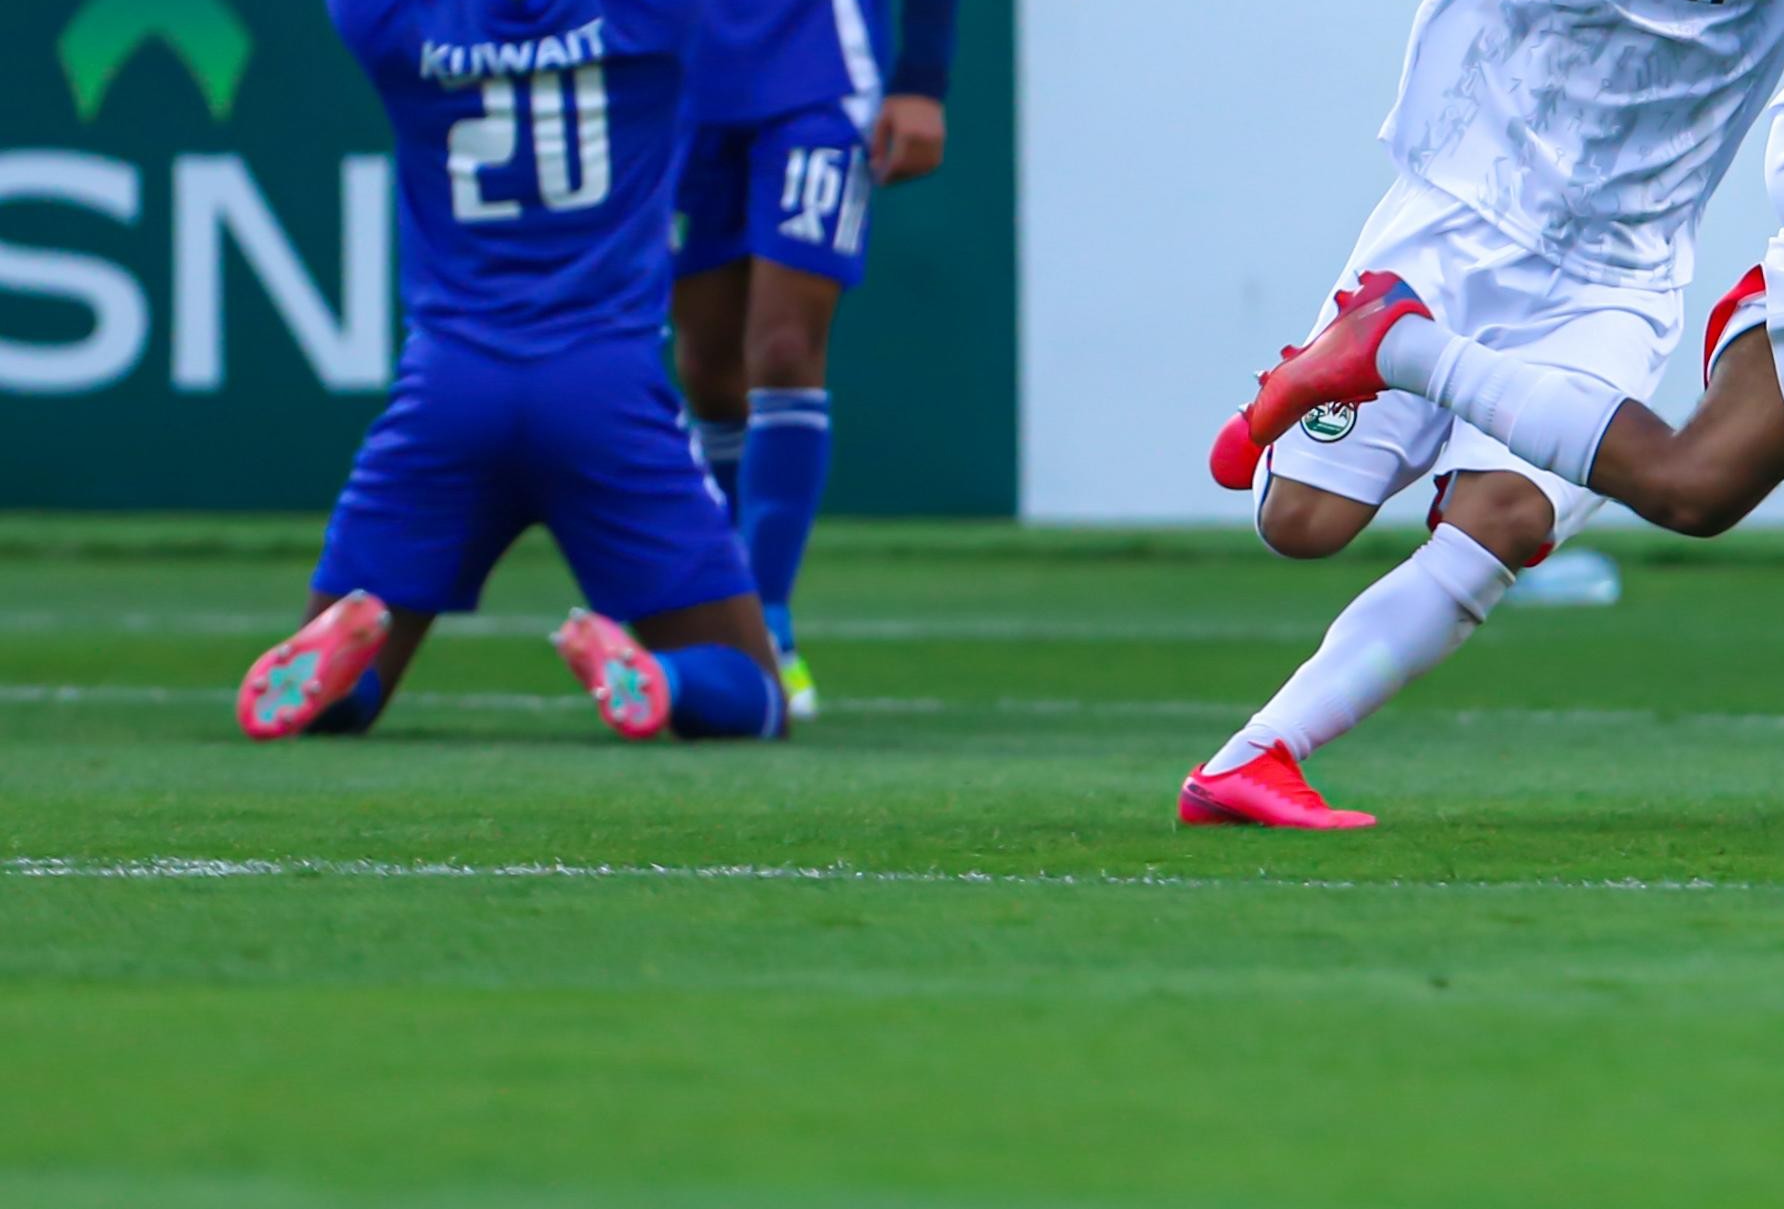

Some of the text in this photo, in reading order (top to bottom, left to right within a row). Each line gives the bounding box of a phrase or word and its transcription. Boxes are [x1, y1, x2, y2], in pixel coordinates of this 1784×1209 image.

[420, 17, 603, 79] KUWAIT
[446, 64, 610, 222] 20
[779, 145, 843, 218] 16
